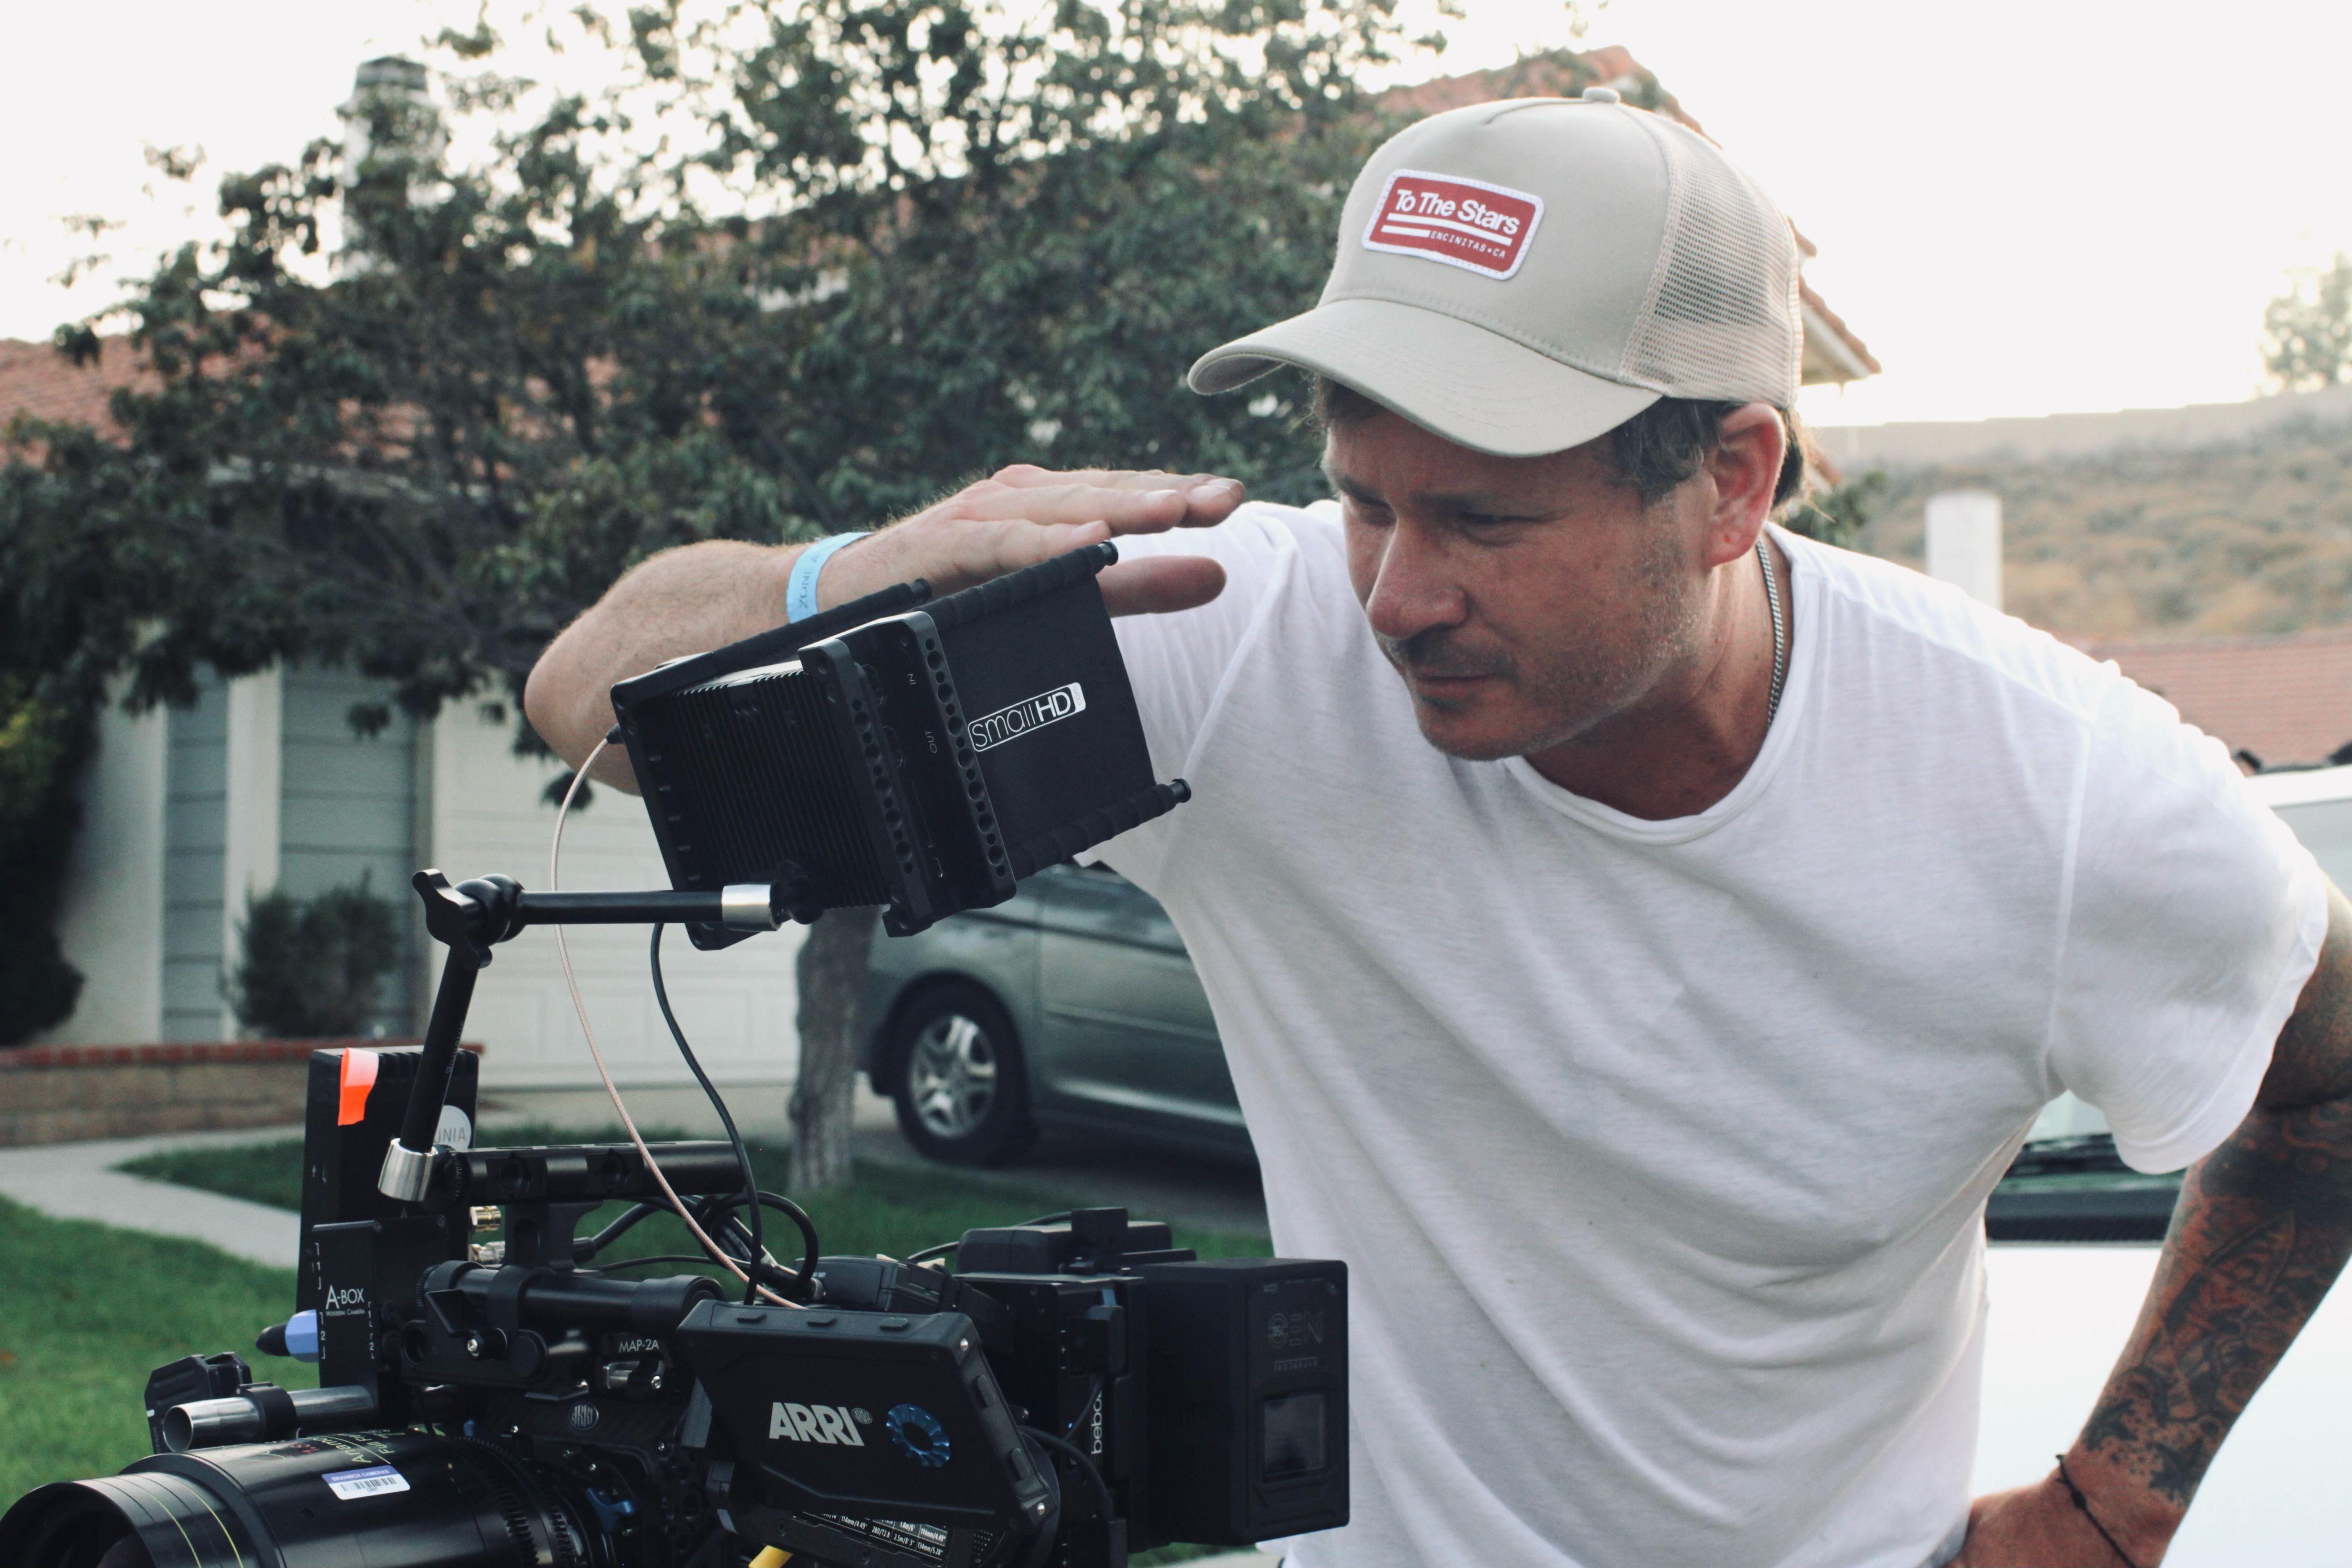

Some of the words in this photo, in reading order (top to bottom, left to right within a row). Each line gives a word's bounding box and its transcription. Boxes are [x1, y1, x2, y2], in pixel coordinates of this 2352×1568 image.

[1396, 189, 1416, 211] To
[1418, 192, 1456, 217] The
[1457, 199, 1520, 235] Stars
[799, 567, 812, 608] ZONE
[907, 673, 916, 685] IN
[972, 691, 1071, 747] smallHD
[925, 730, 937, 754] OUT
[325, 1285, 364, 1309] A-BOX
[321, 1331, 325, 1340] 2
[370, 1342, 374, 1351] 2
[619, 1338, 659, 1353] MAP-2A
[769, 1402, 864, 1446] ARRI
[872, 1526, 890, 1538] 280/T2.8
